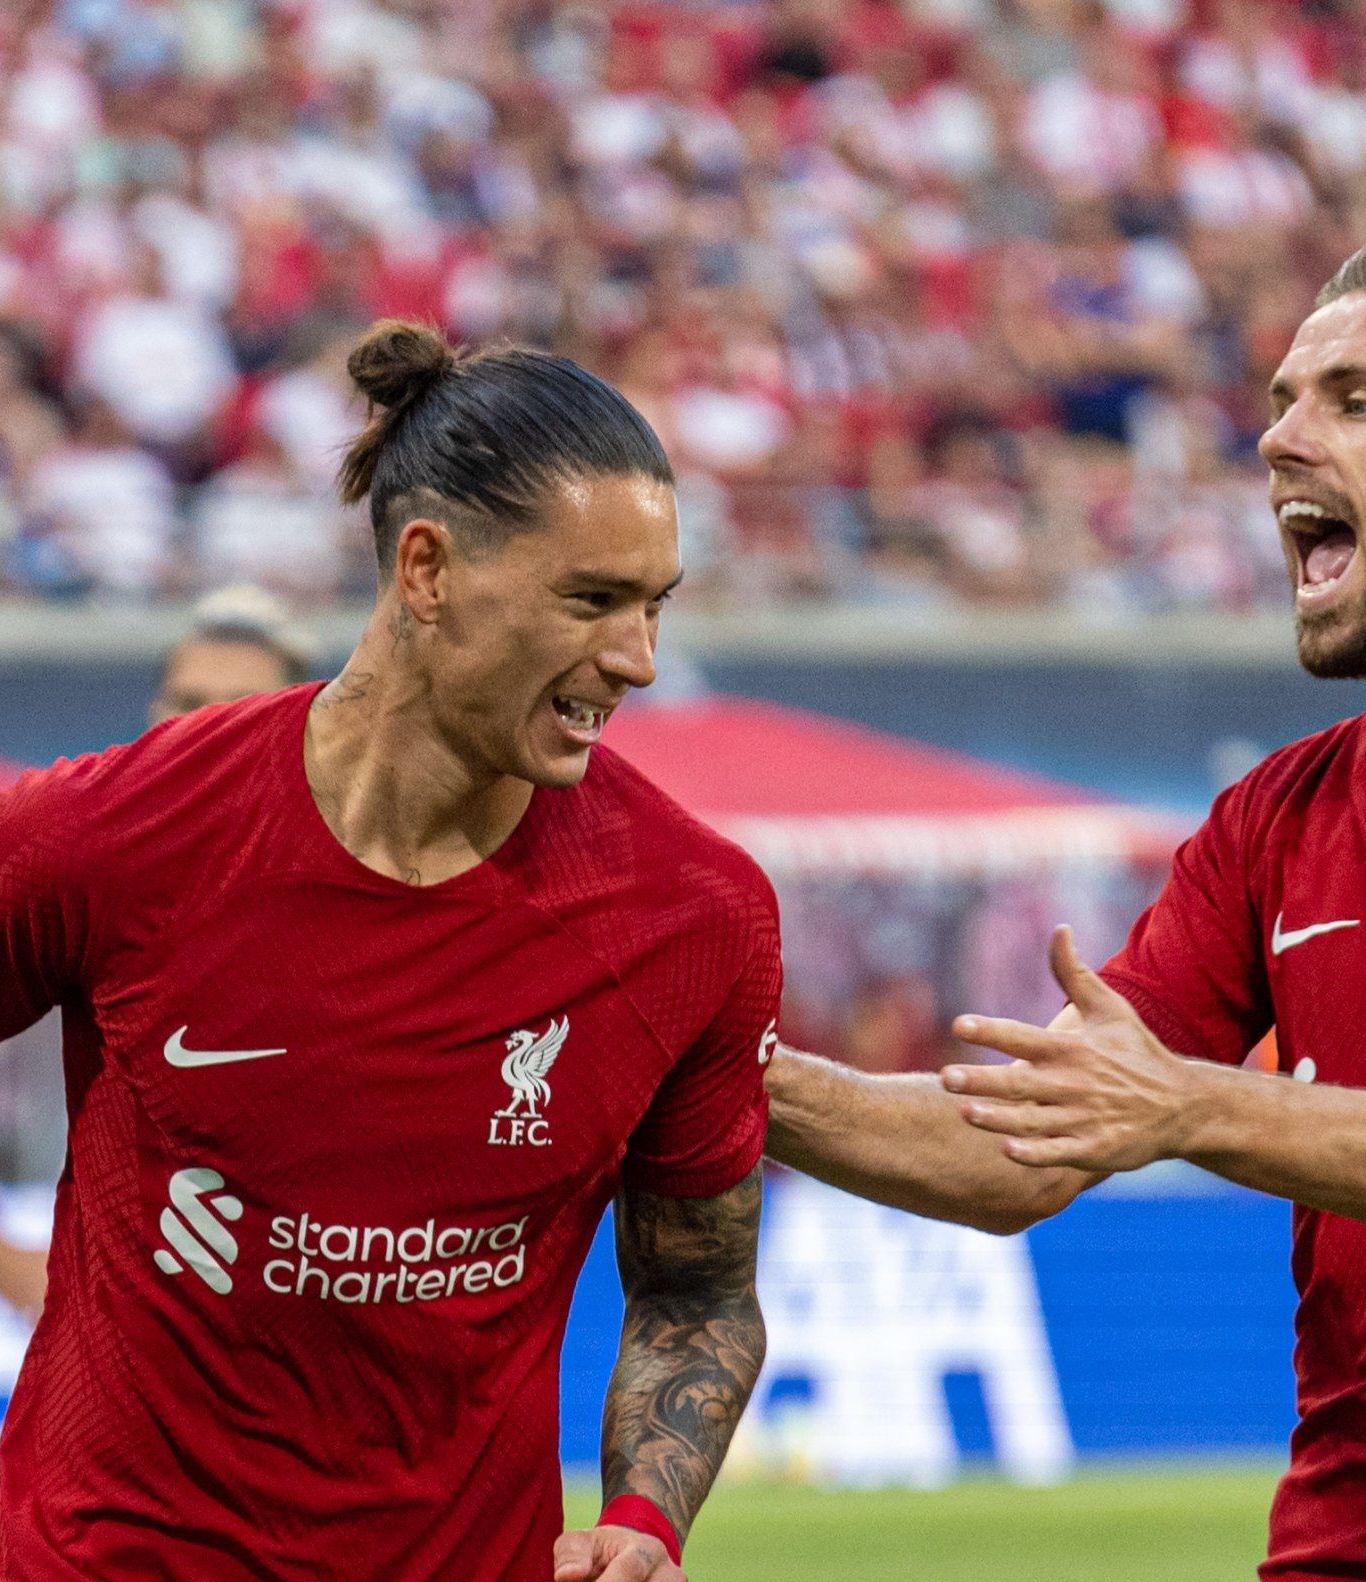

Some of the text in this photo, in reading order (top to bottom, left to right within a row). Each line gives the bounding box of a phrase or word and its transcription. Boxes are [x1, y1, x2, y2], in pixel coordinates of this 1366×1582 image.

[487, 1118, 553, 1146] L.F.C.
[268, 1212, 530, 1263] standard
[263, 1243, 527, 1305] chartered
